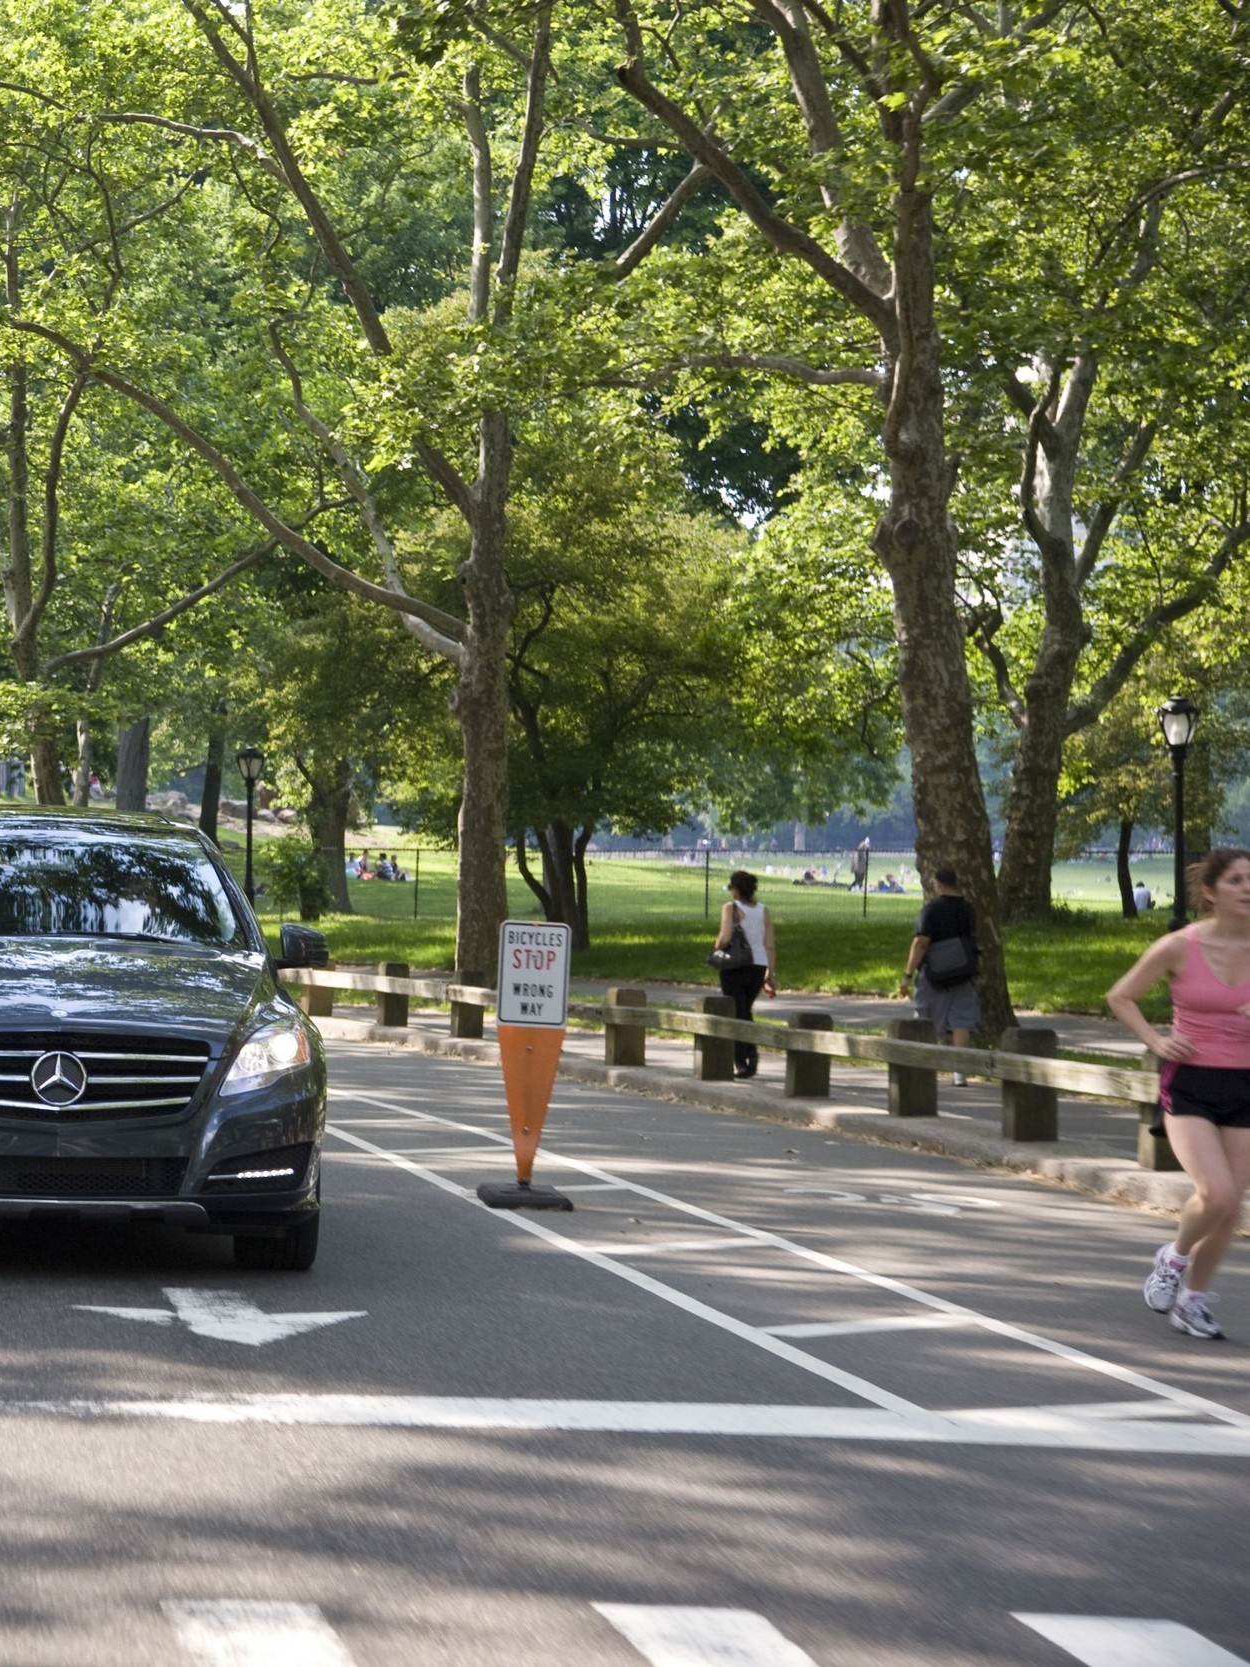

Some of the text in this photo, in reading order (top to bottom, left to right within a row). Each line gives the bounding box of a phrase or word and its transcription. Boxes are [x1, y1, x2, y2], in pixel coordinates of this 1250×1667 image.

[508, 930, 563, 947] BICYCLES
[513, 949, 556, 970] STOP
[513, 983, 554, 998] WRONG
[520, 1002, 544, 1016] WAY
